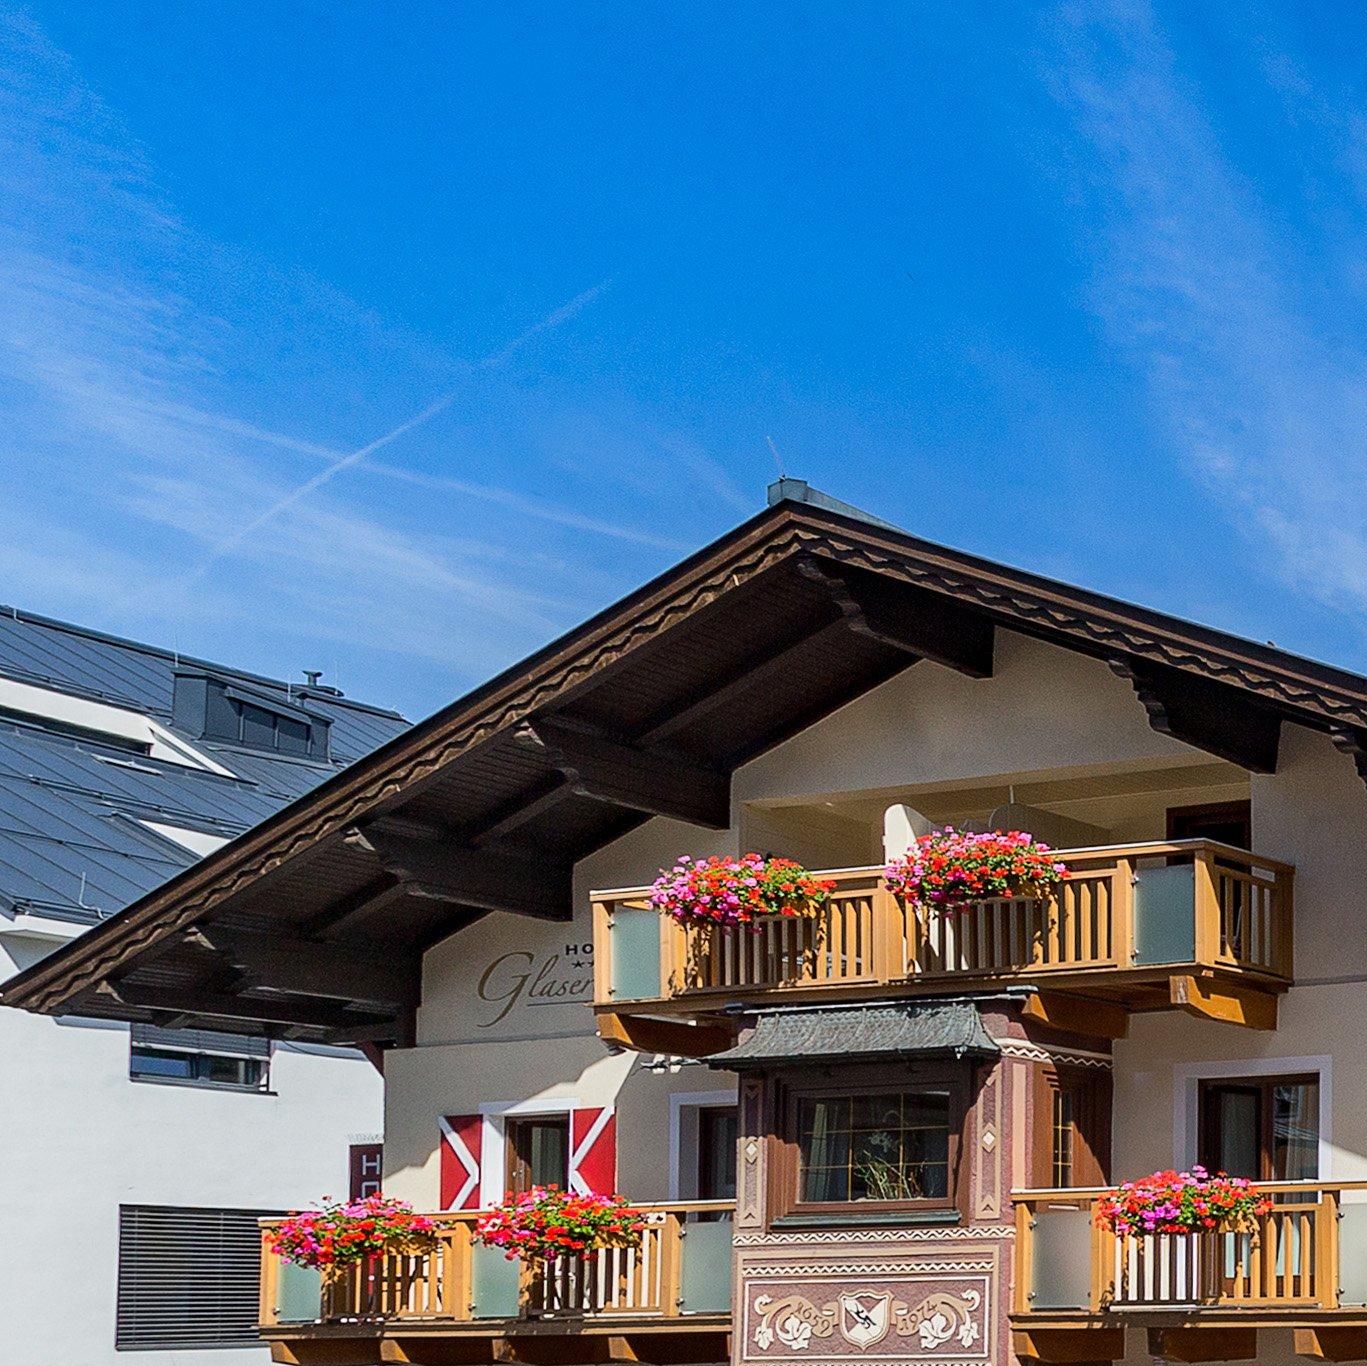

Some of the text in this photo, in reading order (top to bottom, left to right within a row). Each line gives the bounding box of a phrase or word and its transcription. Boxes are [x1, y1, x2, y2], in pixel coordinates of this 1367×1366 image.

[565, 943, 595, 955] HO
[476, 951, 595, 1028] Glaser
[362, 1154, 380, 1199] HO
